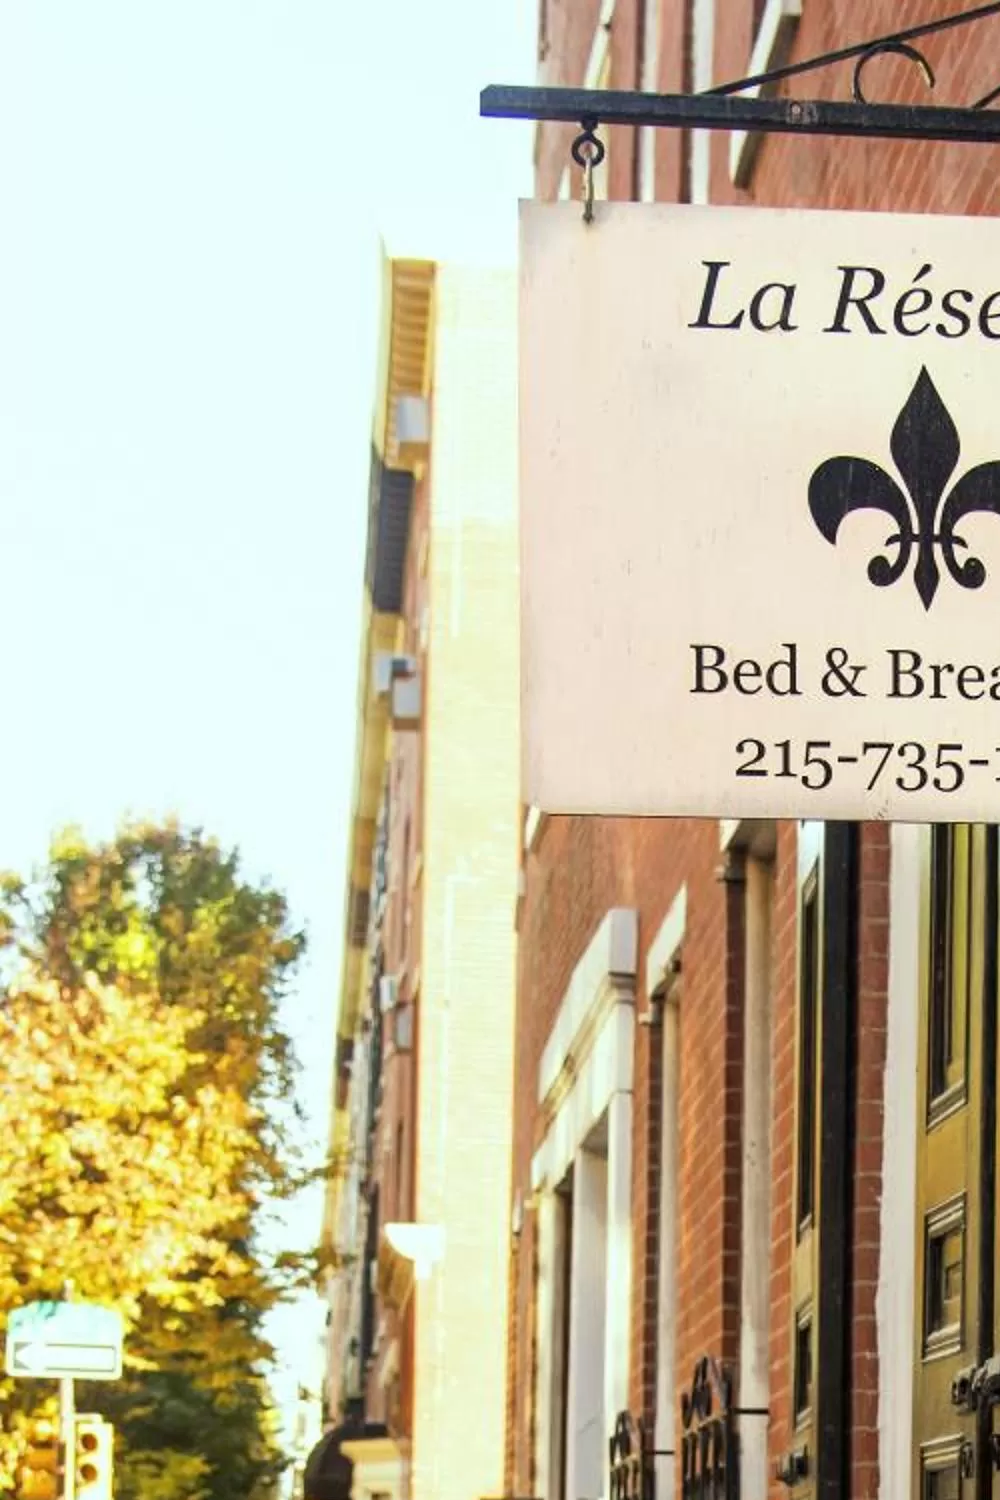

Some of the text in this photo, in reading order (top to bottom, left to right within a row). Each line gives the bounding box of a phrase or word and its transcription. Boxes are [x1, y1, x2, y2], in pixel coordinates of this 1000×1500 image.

[687, 260, 799, 333] La
[689, 643, 803, 697] Bed
[821, 647, 867, 697] &
